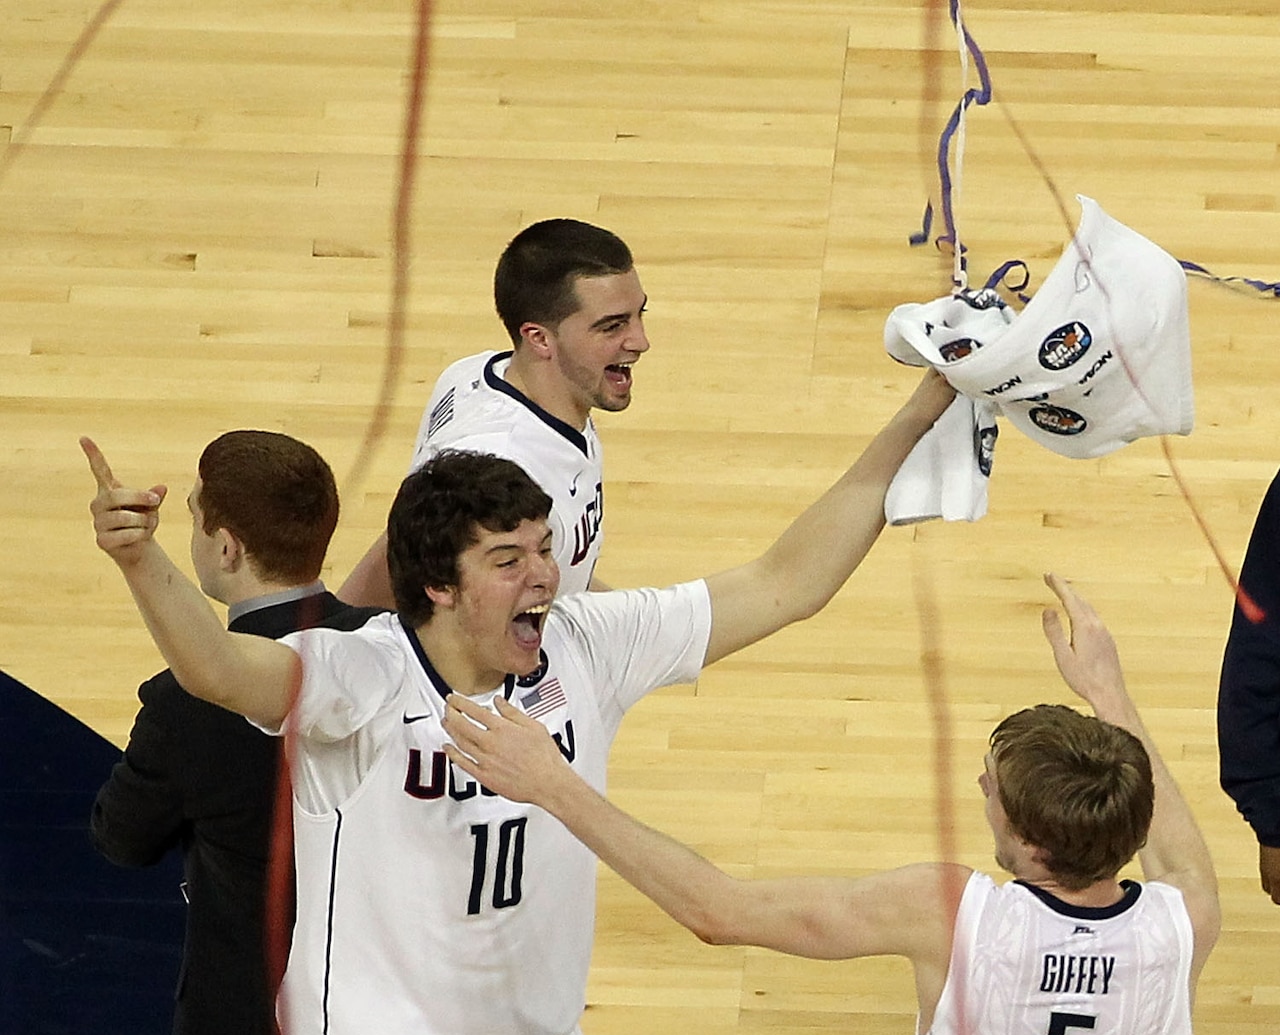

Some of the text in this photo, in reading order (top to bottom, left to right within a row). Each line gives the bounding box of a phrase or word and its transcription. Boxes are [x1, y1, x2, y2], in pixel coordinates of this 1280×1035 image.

[981, 375, 1022, 396] NCAA
[467, 817, 528, 915] 10
[1040, 954, 1115, 994] GIFFEY
